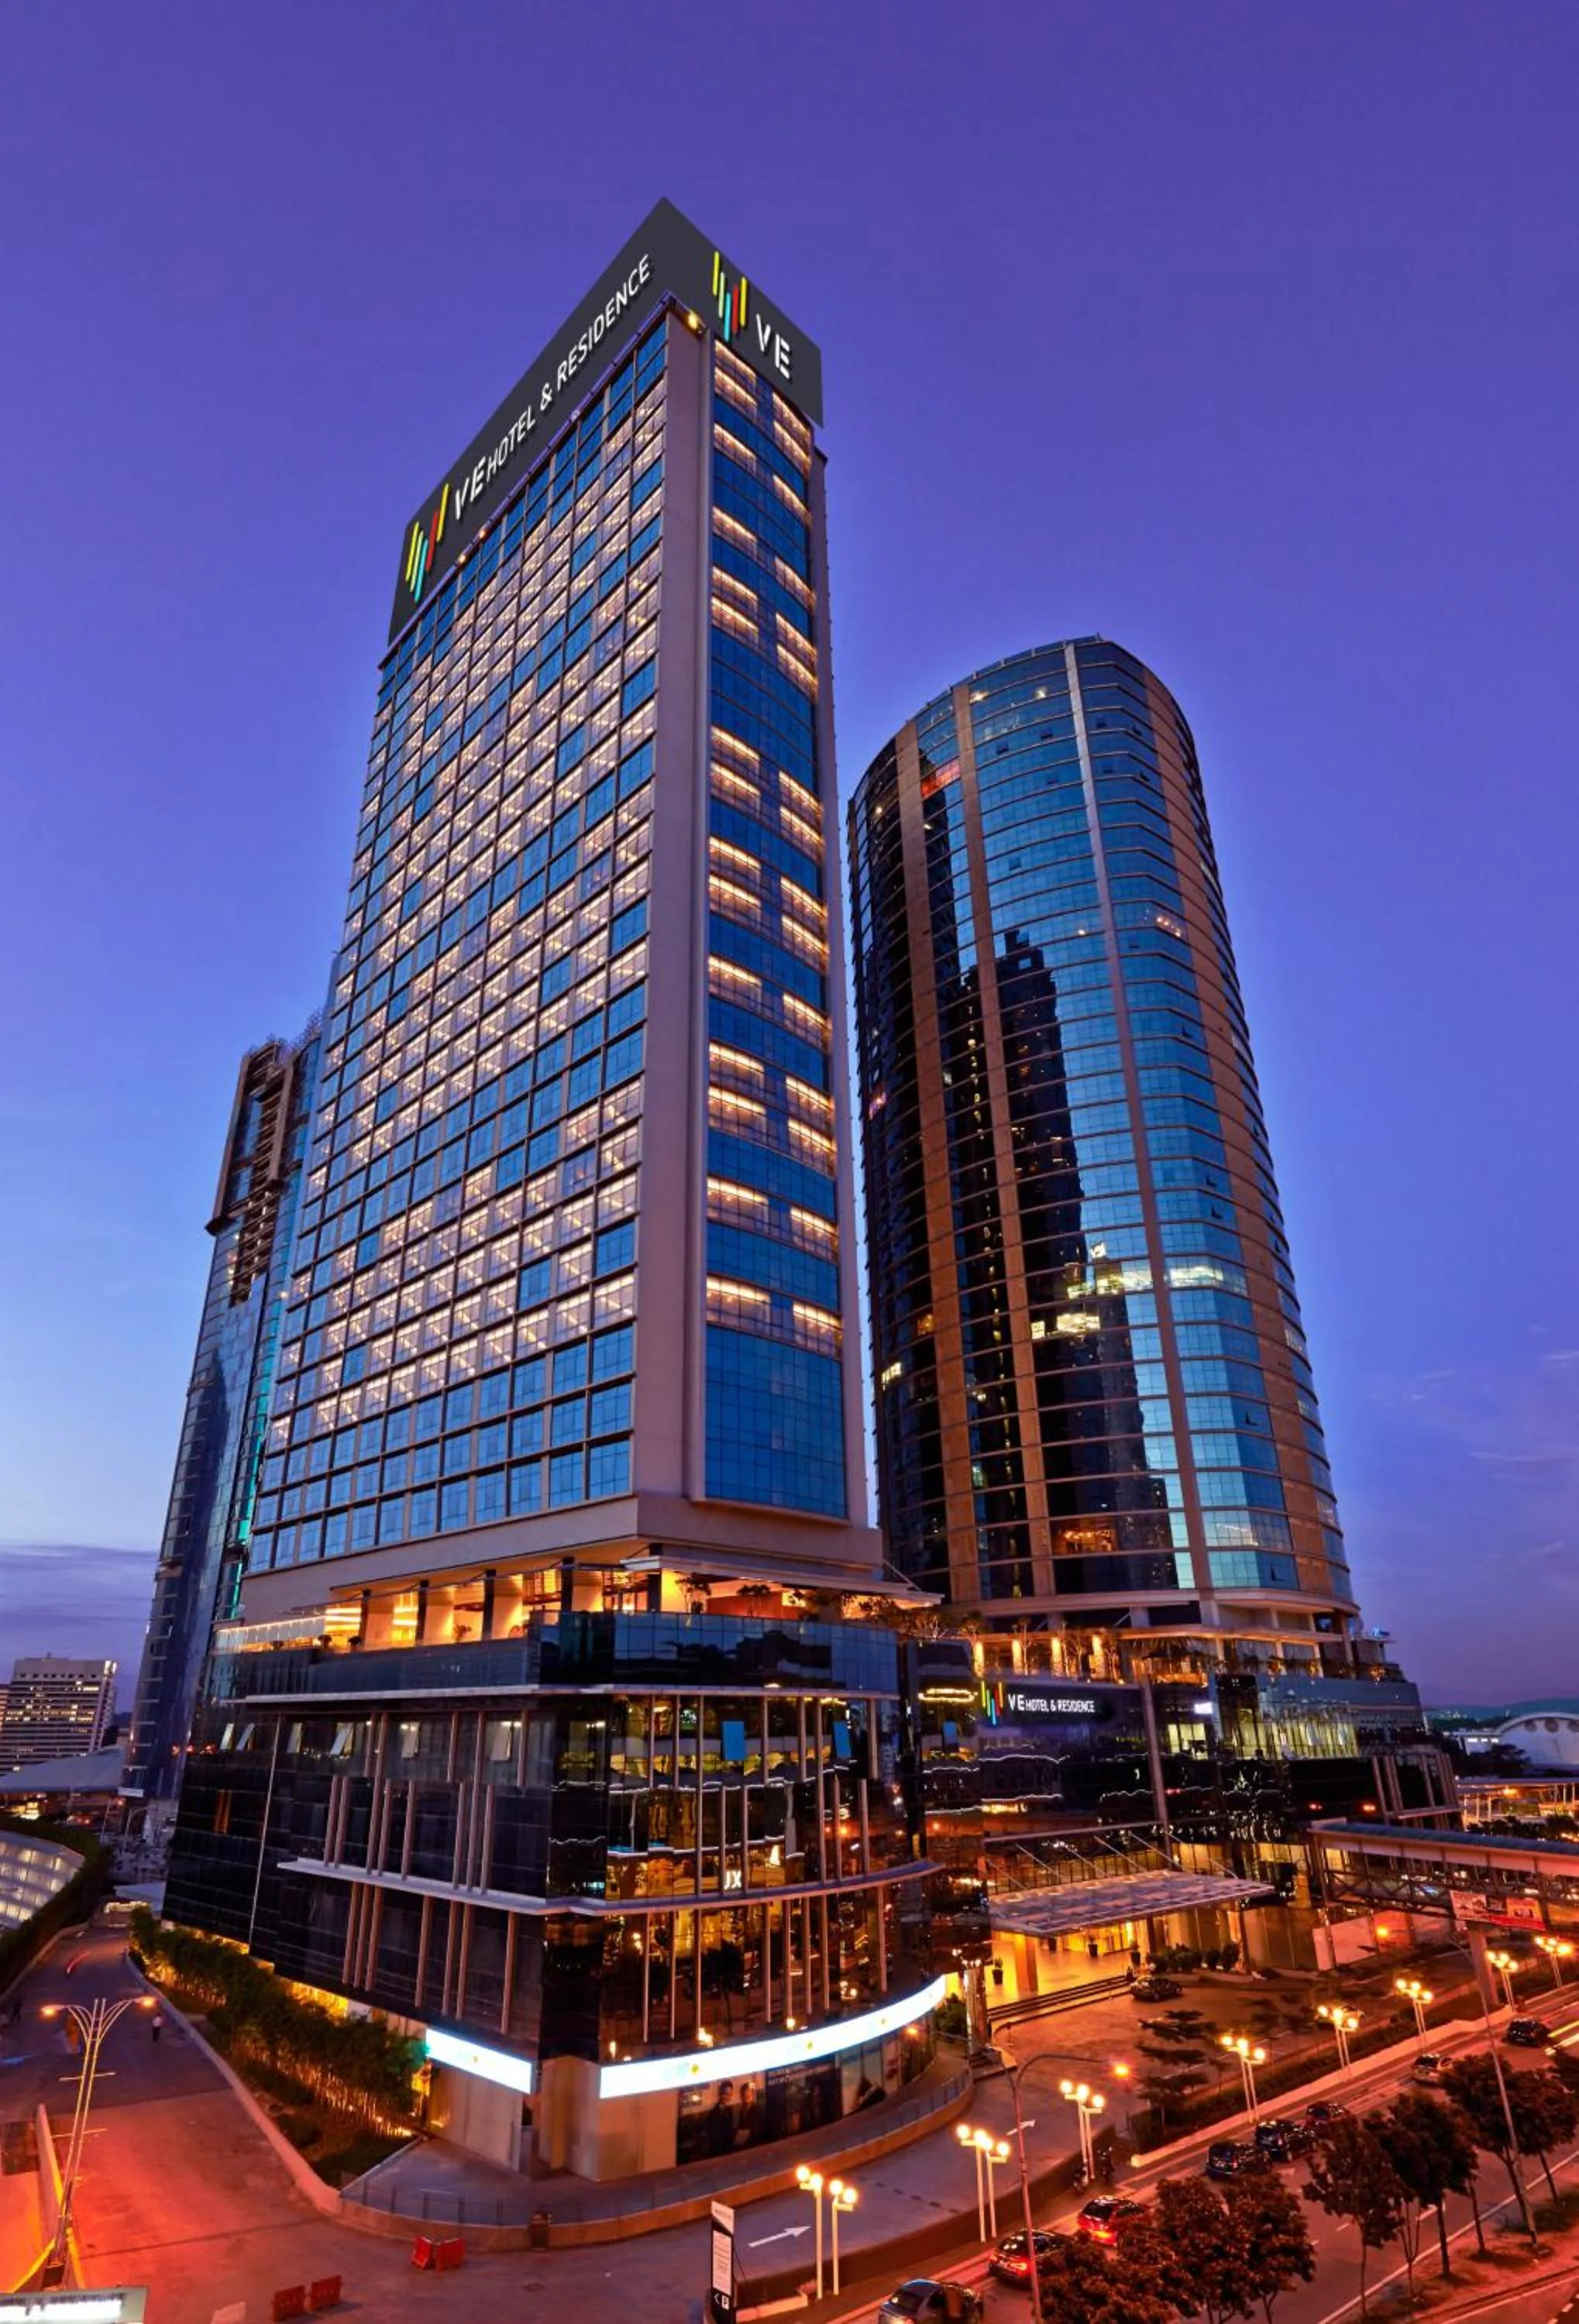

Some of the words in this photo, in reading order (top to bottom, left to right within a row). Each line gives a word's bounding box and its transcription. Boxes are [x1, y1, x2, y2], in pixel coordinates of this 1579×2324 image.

[755, 313, 791, 379] VE
[454, 456, 487, 520] VE
[485, 404, 535, 481] HOTEL
[539, 382, 553, 411] &
[556, 254, 652, 391] RESIDENCE
[1007, 1693, 1025, 1711] VE
[1026, 1699, 1049, 1713] HOTEL
[1051, 1700, 1057, 1712] &
[1058, 1700, 1095, 1713] RESIDENCE
